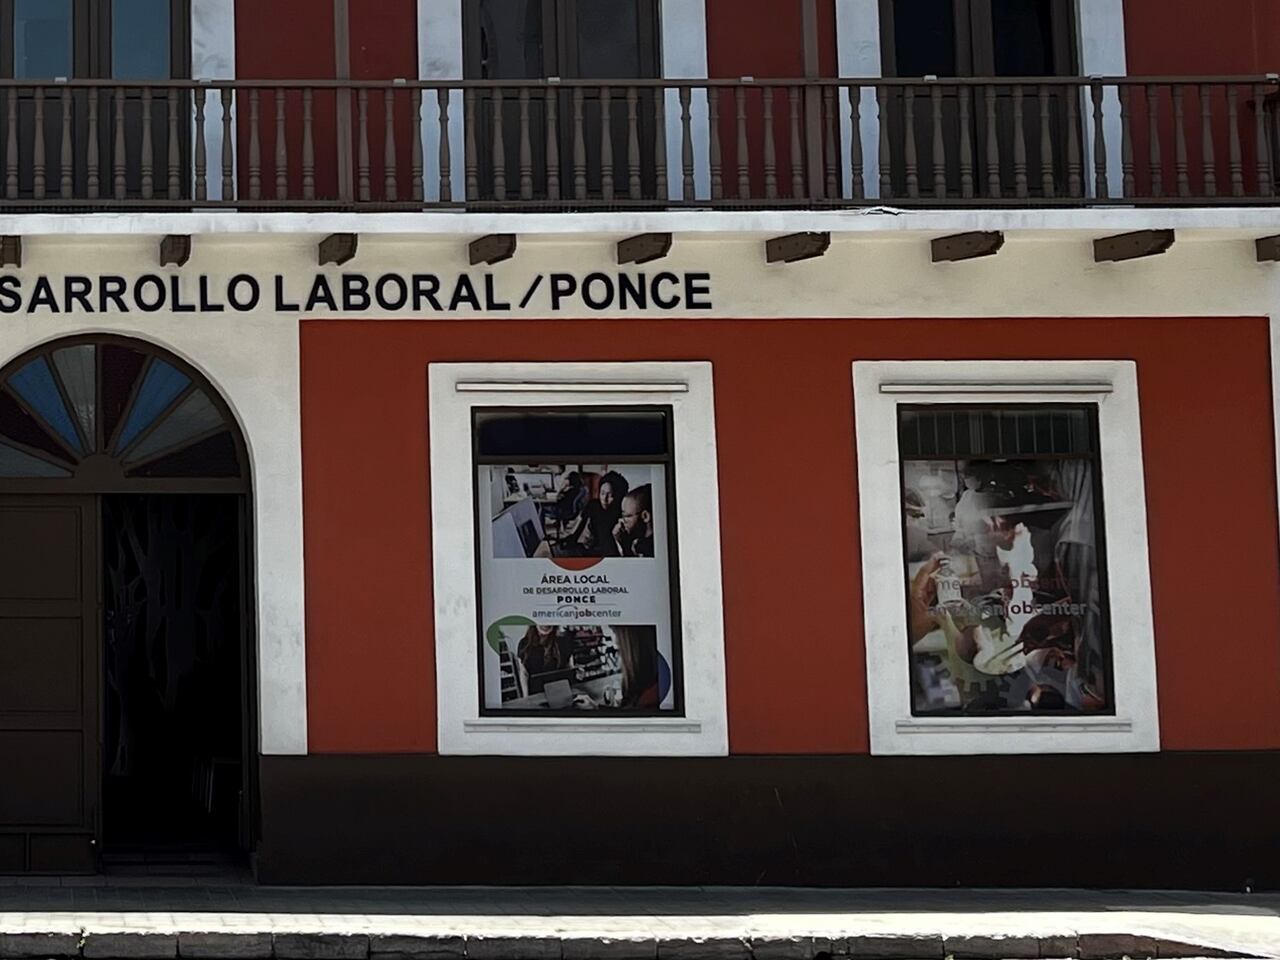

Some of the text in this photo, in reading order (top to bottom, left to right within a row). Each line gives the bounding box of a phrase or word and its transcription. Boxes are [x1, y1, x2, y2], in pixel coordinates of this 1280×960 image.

[541, 573, 610, 584] ÁREA LOCAL
[522, 587, 534, 595] DE
[536, 587, 590, 595] DESARROLLO
[556, 595, 596, 604] PONCE
[532, 608, 622, 619] americanjobcenter
